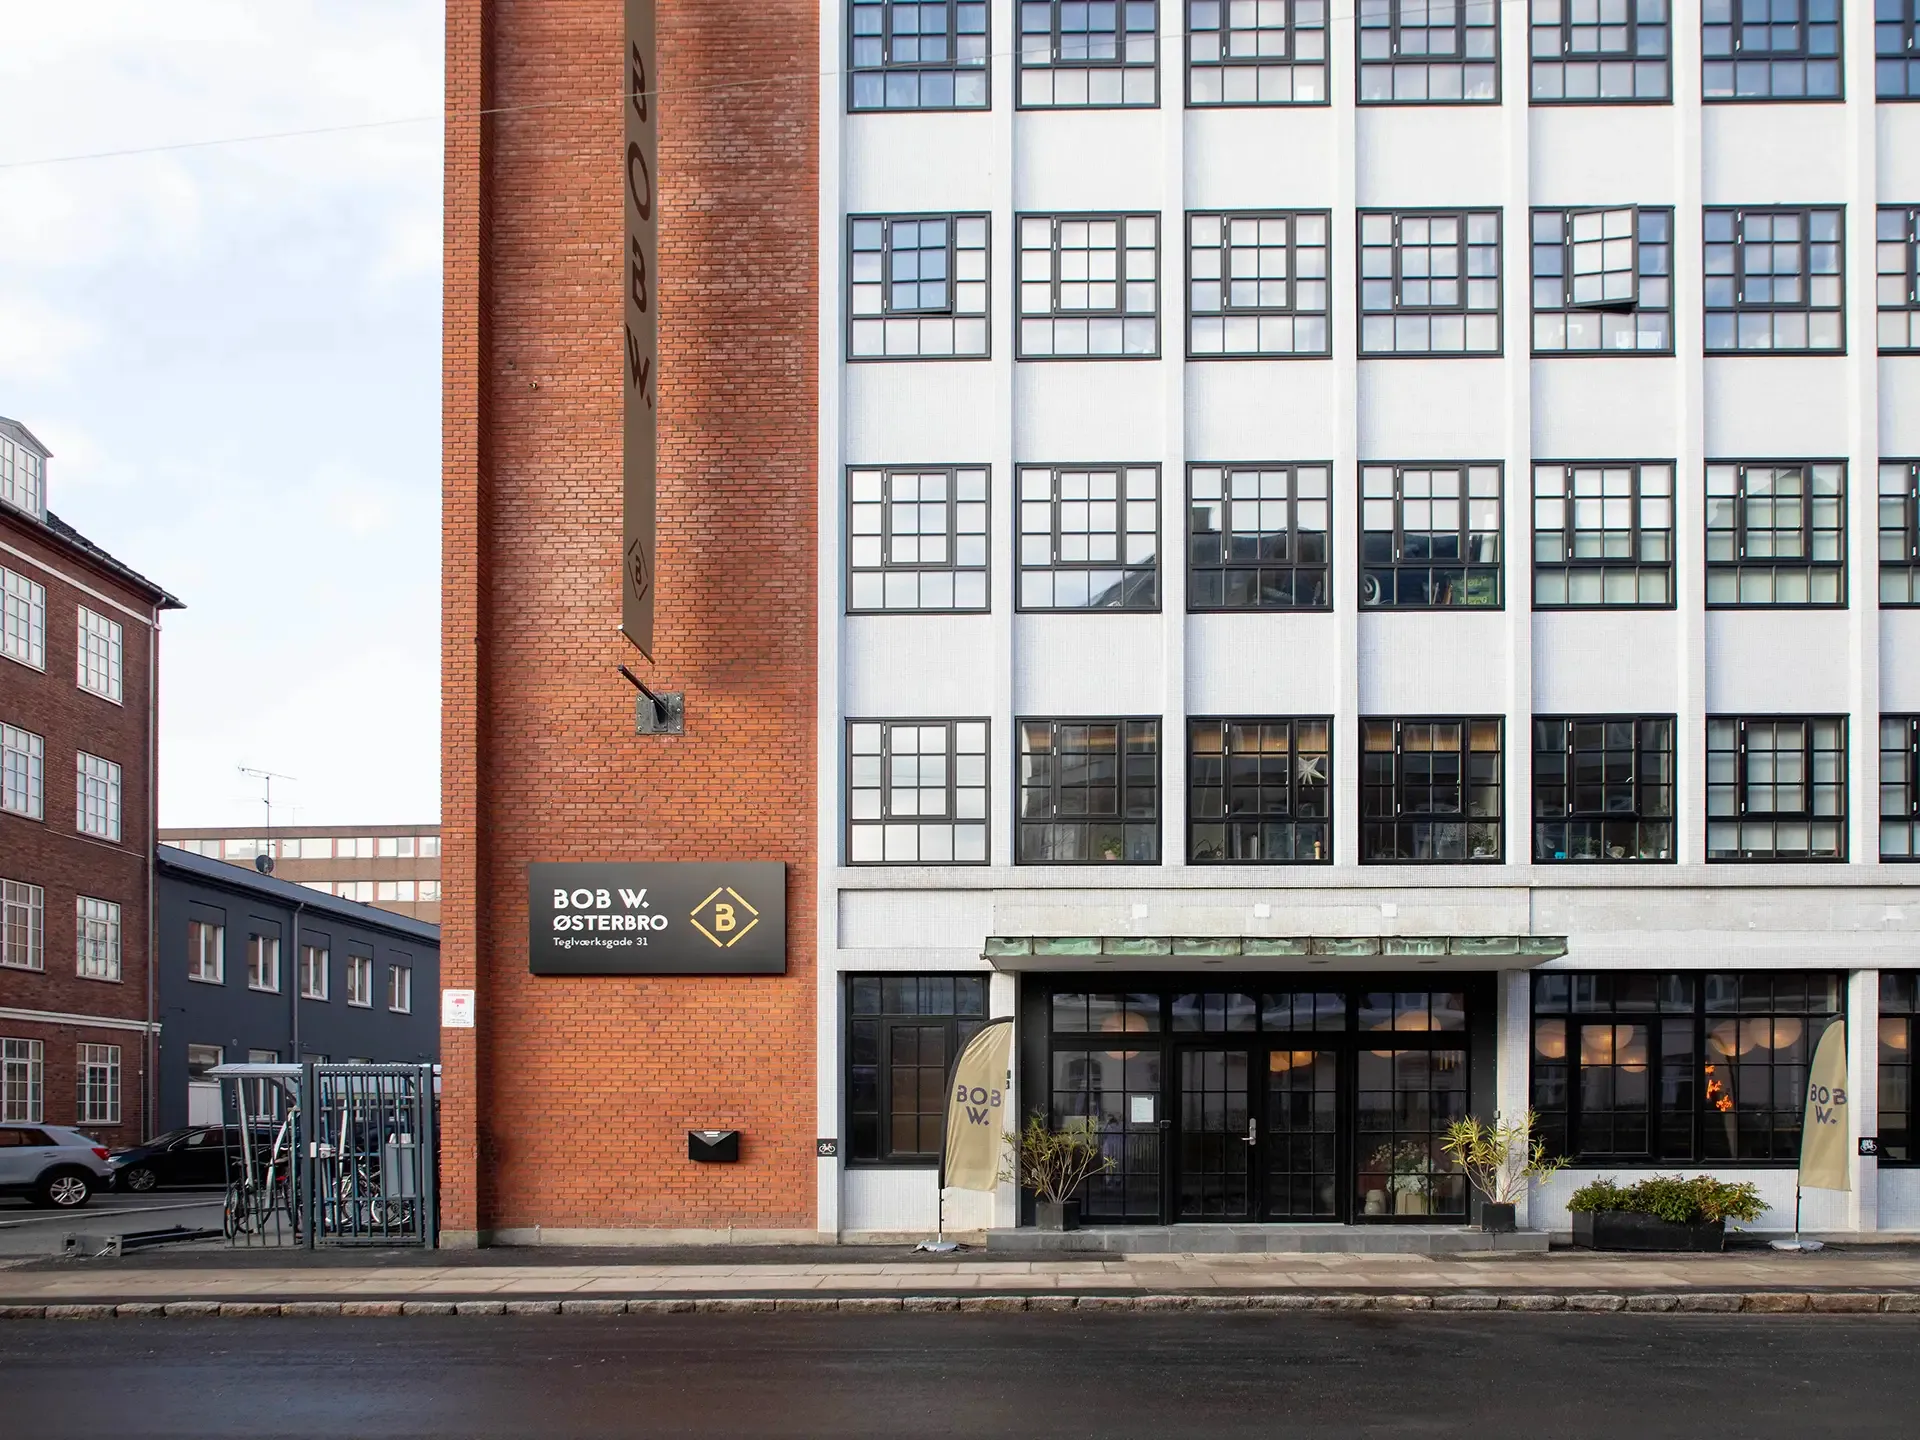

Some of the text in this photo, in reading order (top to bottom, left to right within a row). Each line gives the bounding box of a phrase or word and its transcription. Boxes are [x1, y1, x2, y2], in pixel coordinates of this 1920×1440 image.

[625, 40, 652, 410] BOB W.
[635, 555, 642, 586] B
[553, 888, 650, 909] BOB W.
[553, 914, 668, 931] ØSTERBRO
[715, 903, 737, 932] B
[553, 937, 648, 950] Teglværksgade 31
[956, 1084, 1002, 1107] BOB
[1810, 1083, 1848, 1106] BOB
[966, 1105, 990, 1126] W.
[1815, 1105, 1838, 1125] W.
